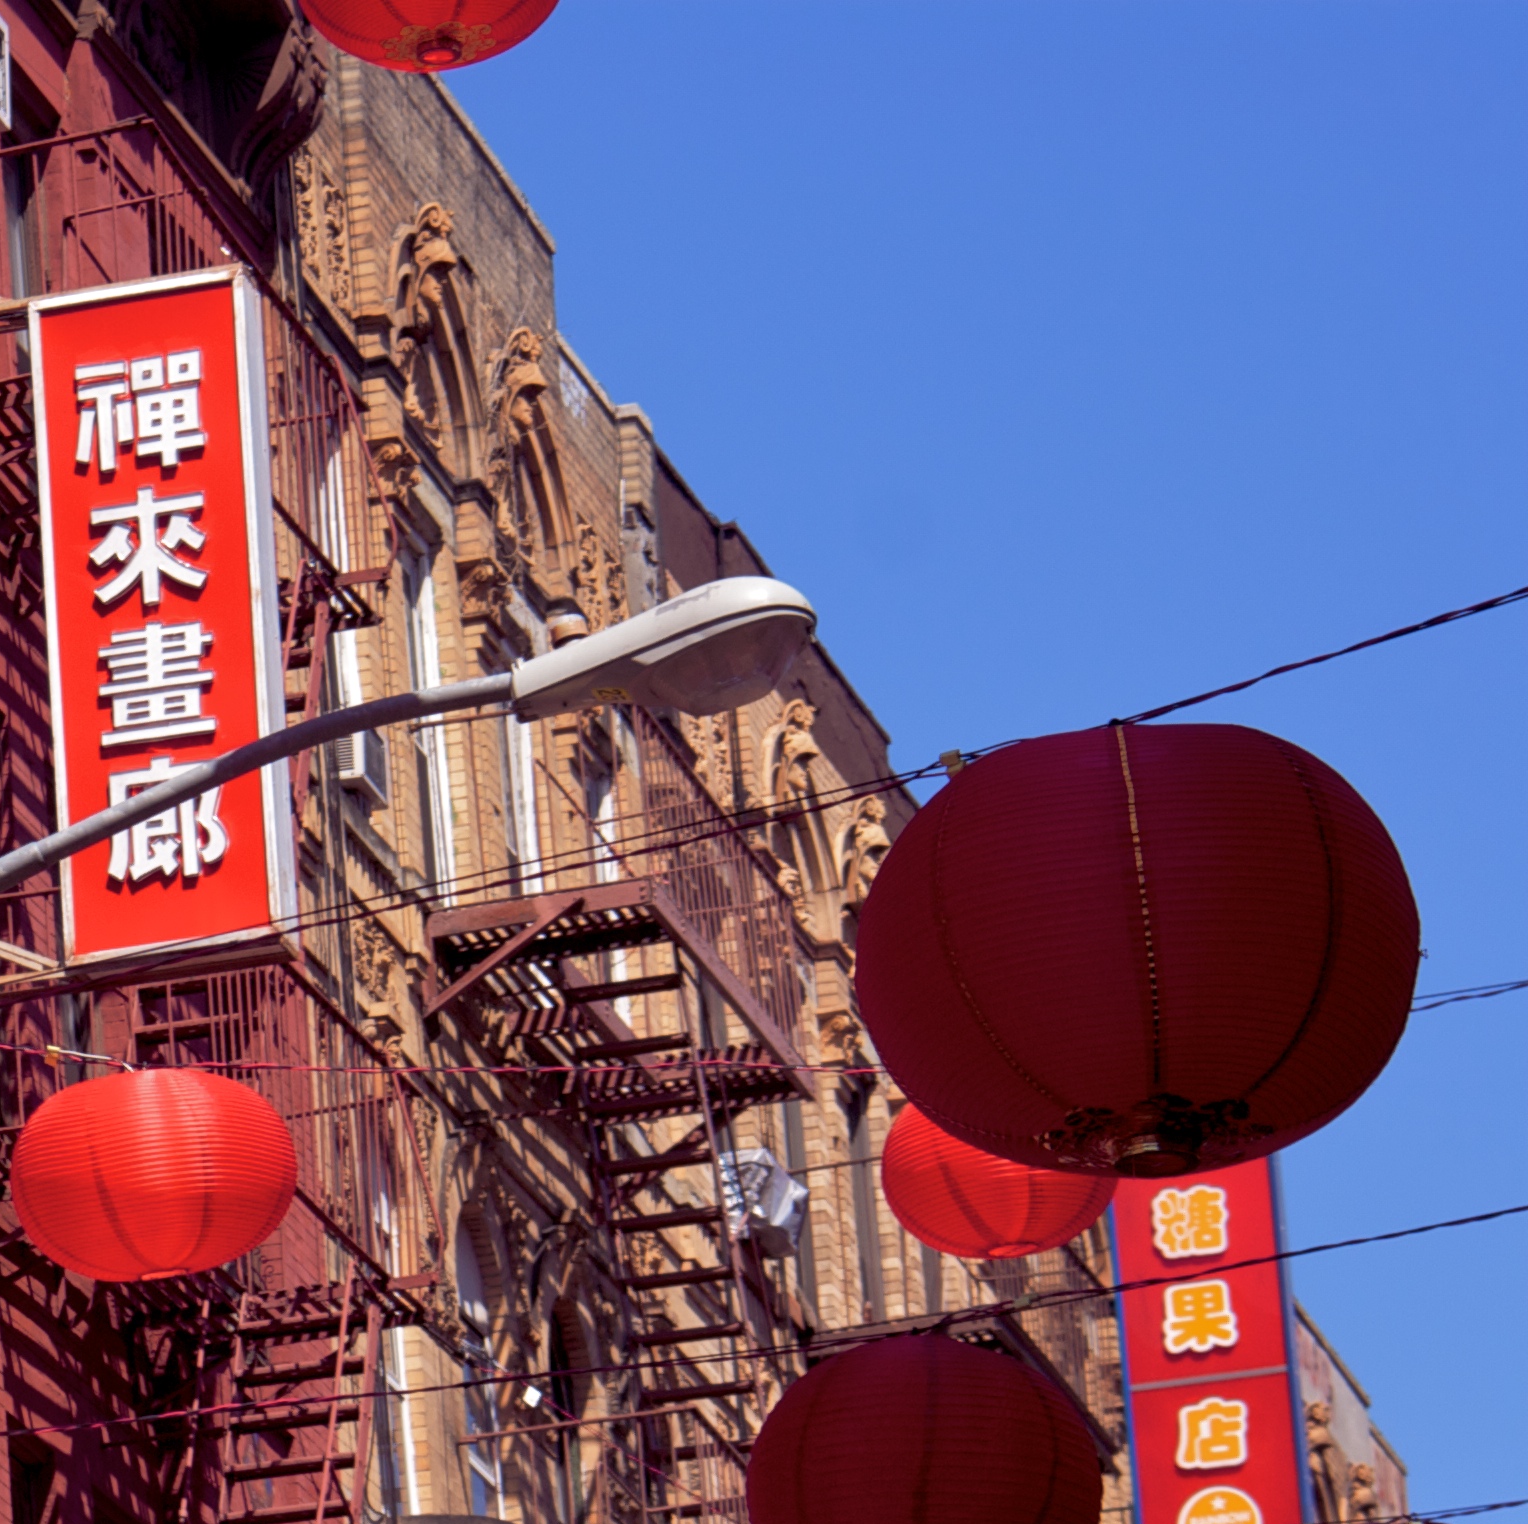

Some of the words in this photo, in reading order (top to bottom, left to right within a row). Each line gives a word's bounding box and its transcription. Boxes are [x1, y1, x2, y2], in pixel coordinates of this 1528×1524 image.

[74, 348, 228, 881] 禪來畫廊
[1151, 1184, 1248, 1470] 糖果店
